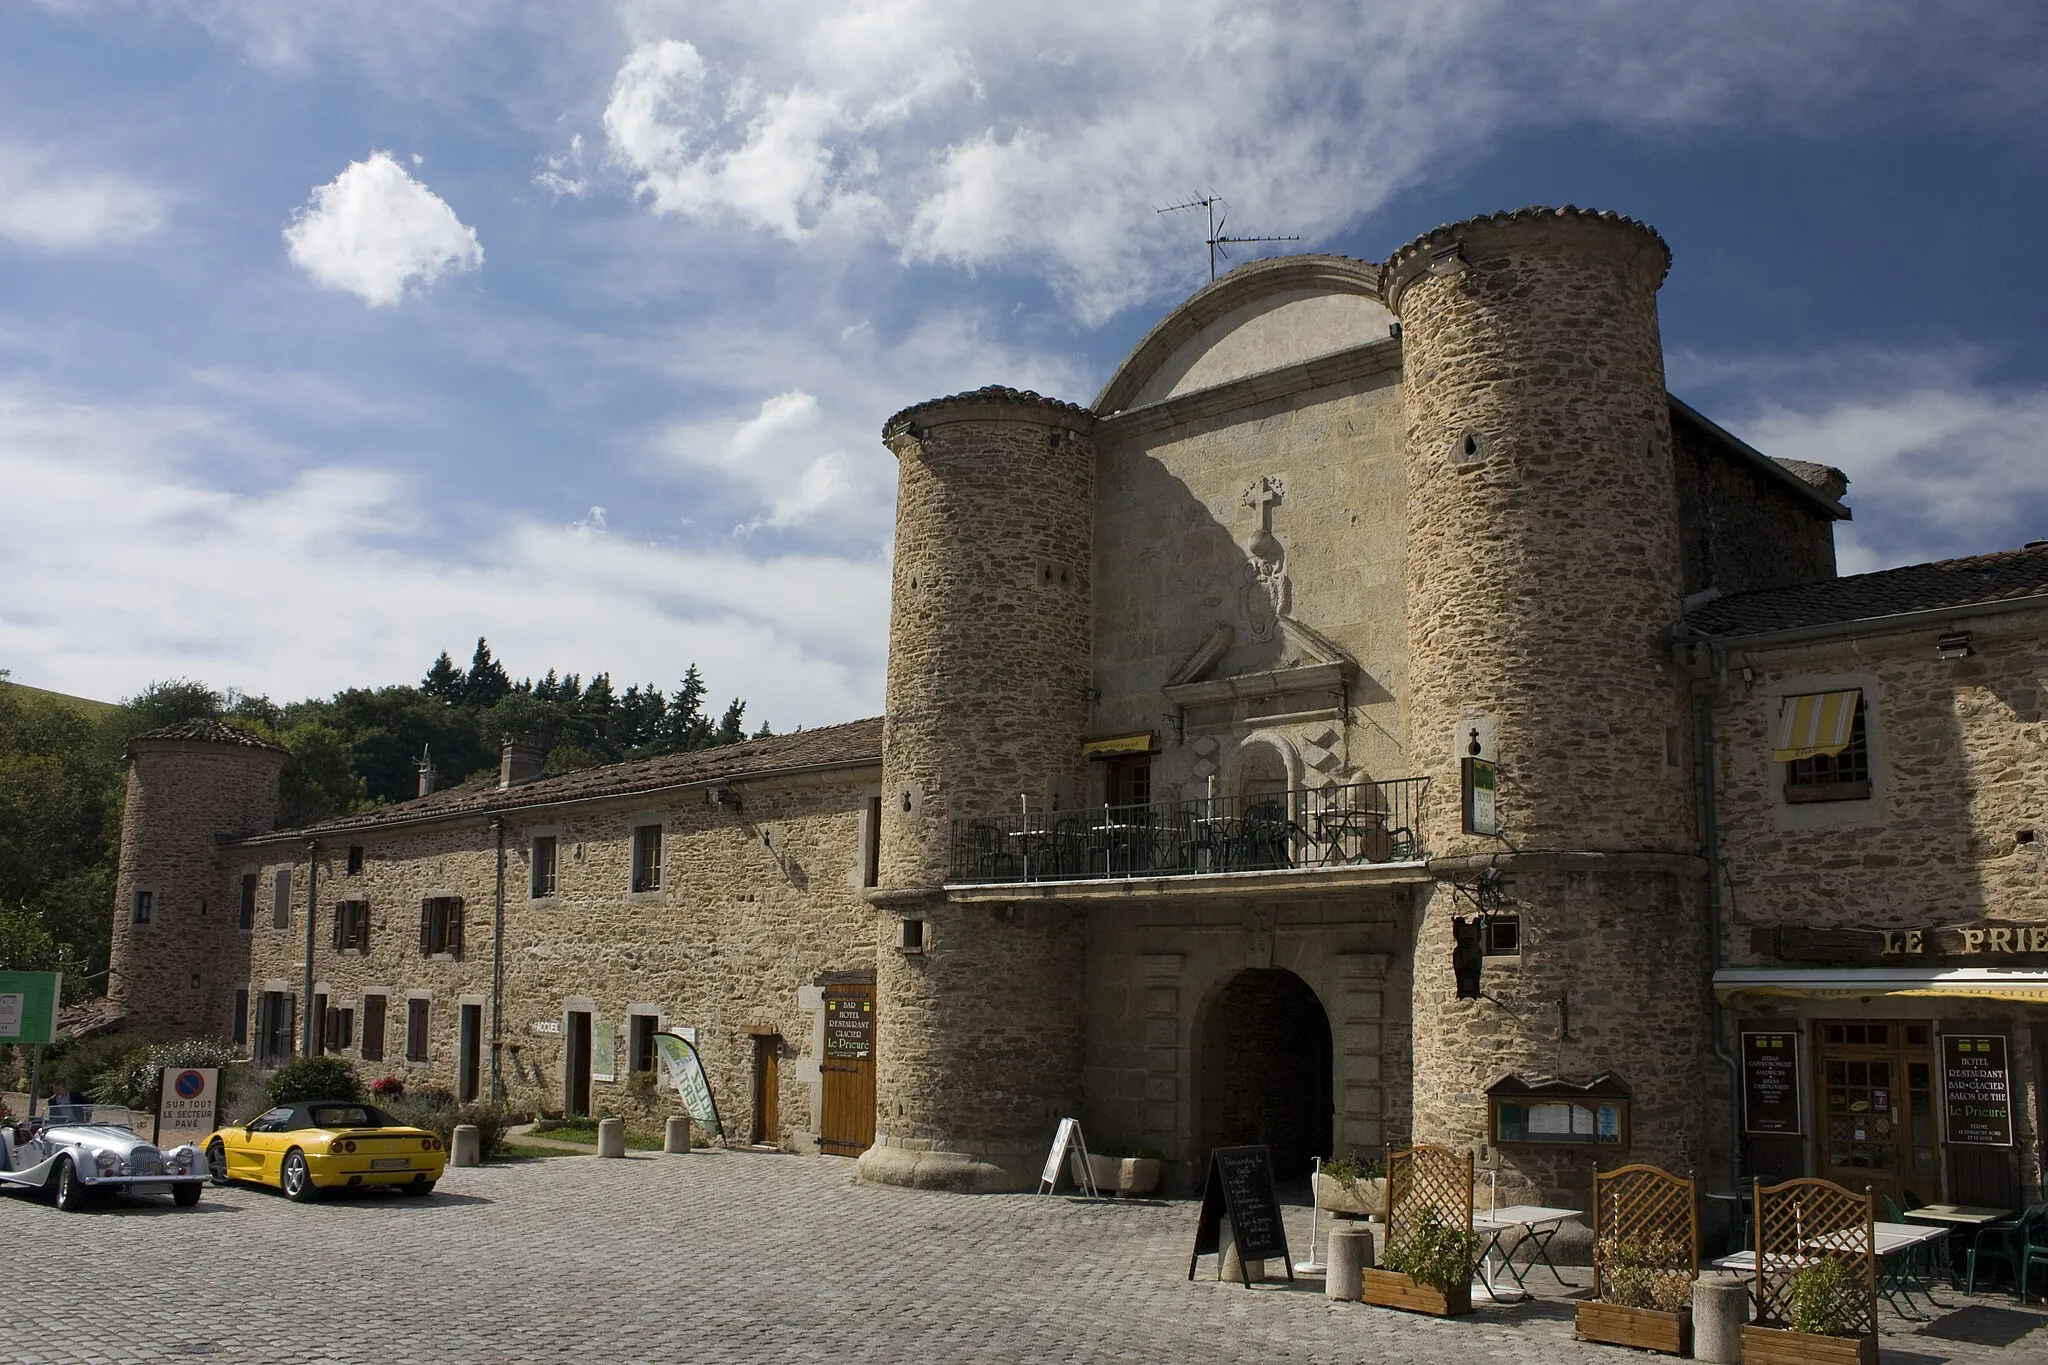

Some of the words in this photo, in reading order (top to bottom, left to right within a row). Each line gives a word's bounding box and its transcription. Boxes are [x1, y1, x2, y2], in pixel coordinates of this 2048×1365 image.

[1881, 929, 1924, 954] LE
[1958, 927, 2048, 954] PRIE
[843, 1001, 856, 1009] BAR
[839, 1011, 860, 1019] HOTEL
[829, 1020, 869, 1028] RESTAURANT
[835, 1030, 861, 1038] GLACIER
[828, 1037, 838, 1048] Le
[839, 1037, 870, 1050] Prieuré
[1961, 1057, 1989, 1066] HOTEL
[1949, 1069, 2003, 1078] RESTAURANT
[1949, 1092, 1976, 1101] SALON
[1977, 1092, 1989, 1101] DE
[163, 1110, 173, 1118] LE
[177, 1110, 213, 1118] SECTEUR
[1950, 1104, 1962, 1116] Le
[1965, 1105, 2007, 1118] Prieuré
[175, 1119, 198, 1127] PAVÉ
